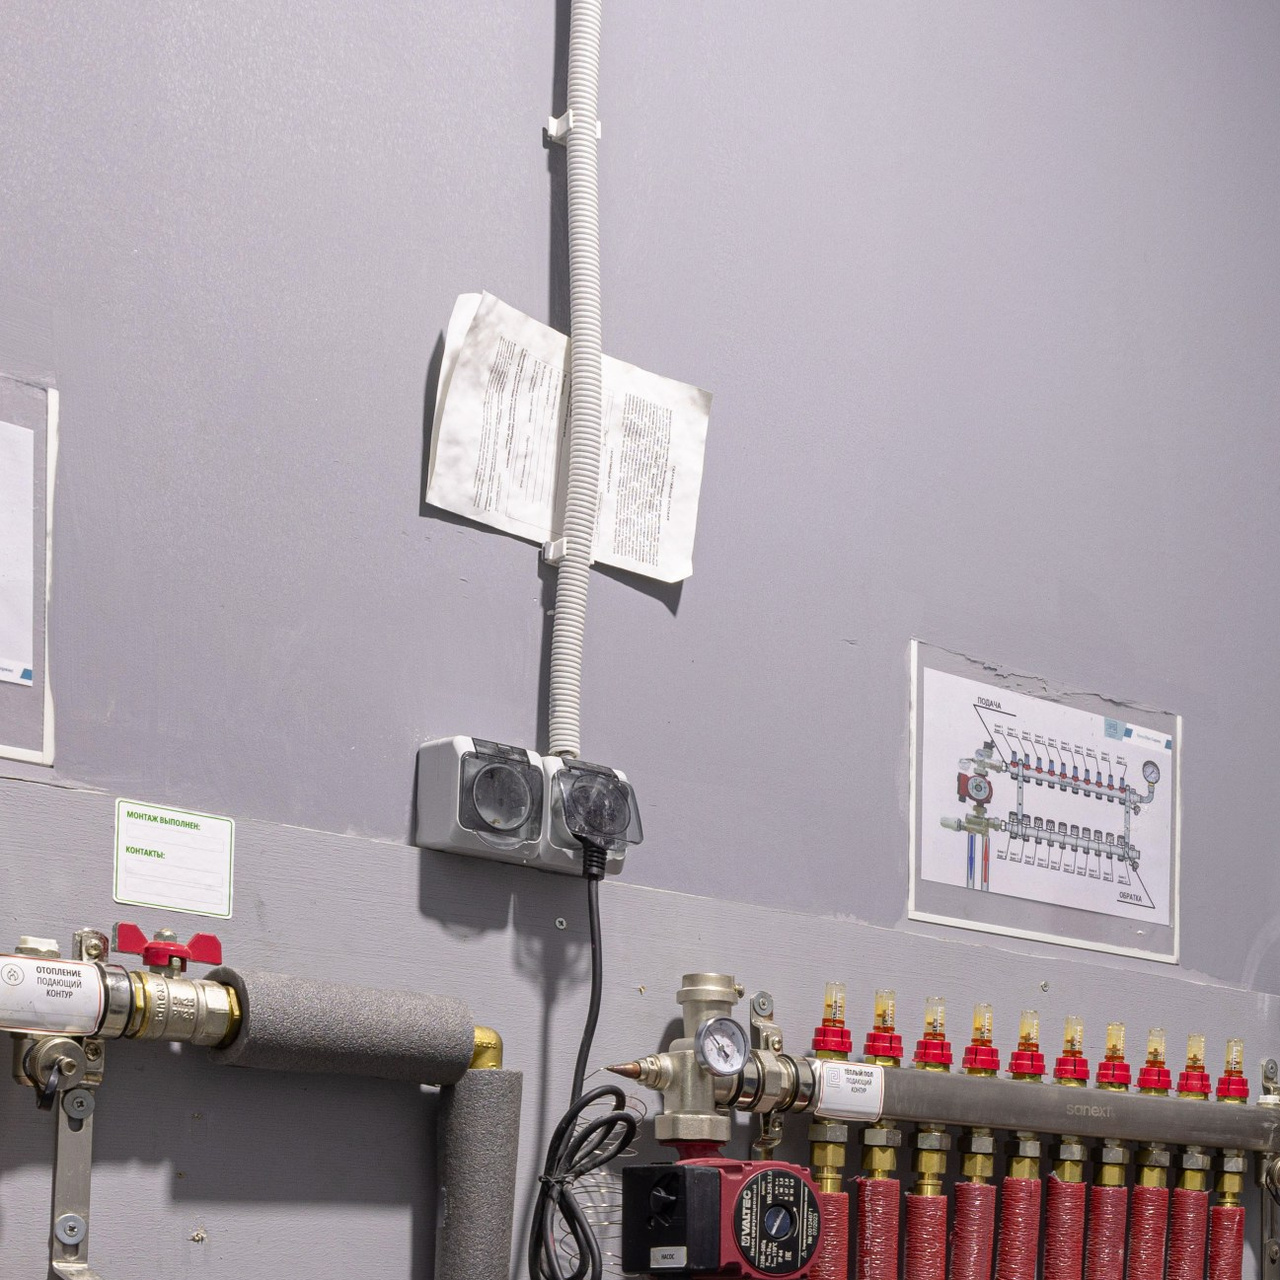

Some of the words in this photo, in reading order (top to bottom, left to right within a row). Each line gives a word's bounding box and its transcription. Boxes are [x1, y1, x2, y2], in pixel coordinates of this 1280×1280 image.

[977, 696, 1002, 710] ПОДАЧА
[126, 810, 159, 823] МОНТАЖ
[159, 816, 201, 831] ВЫПОЛНЕН:
[125, 846, 166, 859] КОНТАКТЫ:
[1119, 891, 1143, 903] ОБРАТКА
[36, 966, 82, 978] ОТОПЛЕНИЕ
[37, 976, 82, 989] ПОДАЮЩИЙ
[46, 990, 73, 999] КОНТУР
[1066, 1104, 1112, 1118] sanext
[742, 1190, 751, 1236] VALTEC
